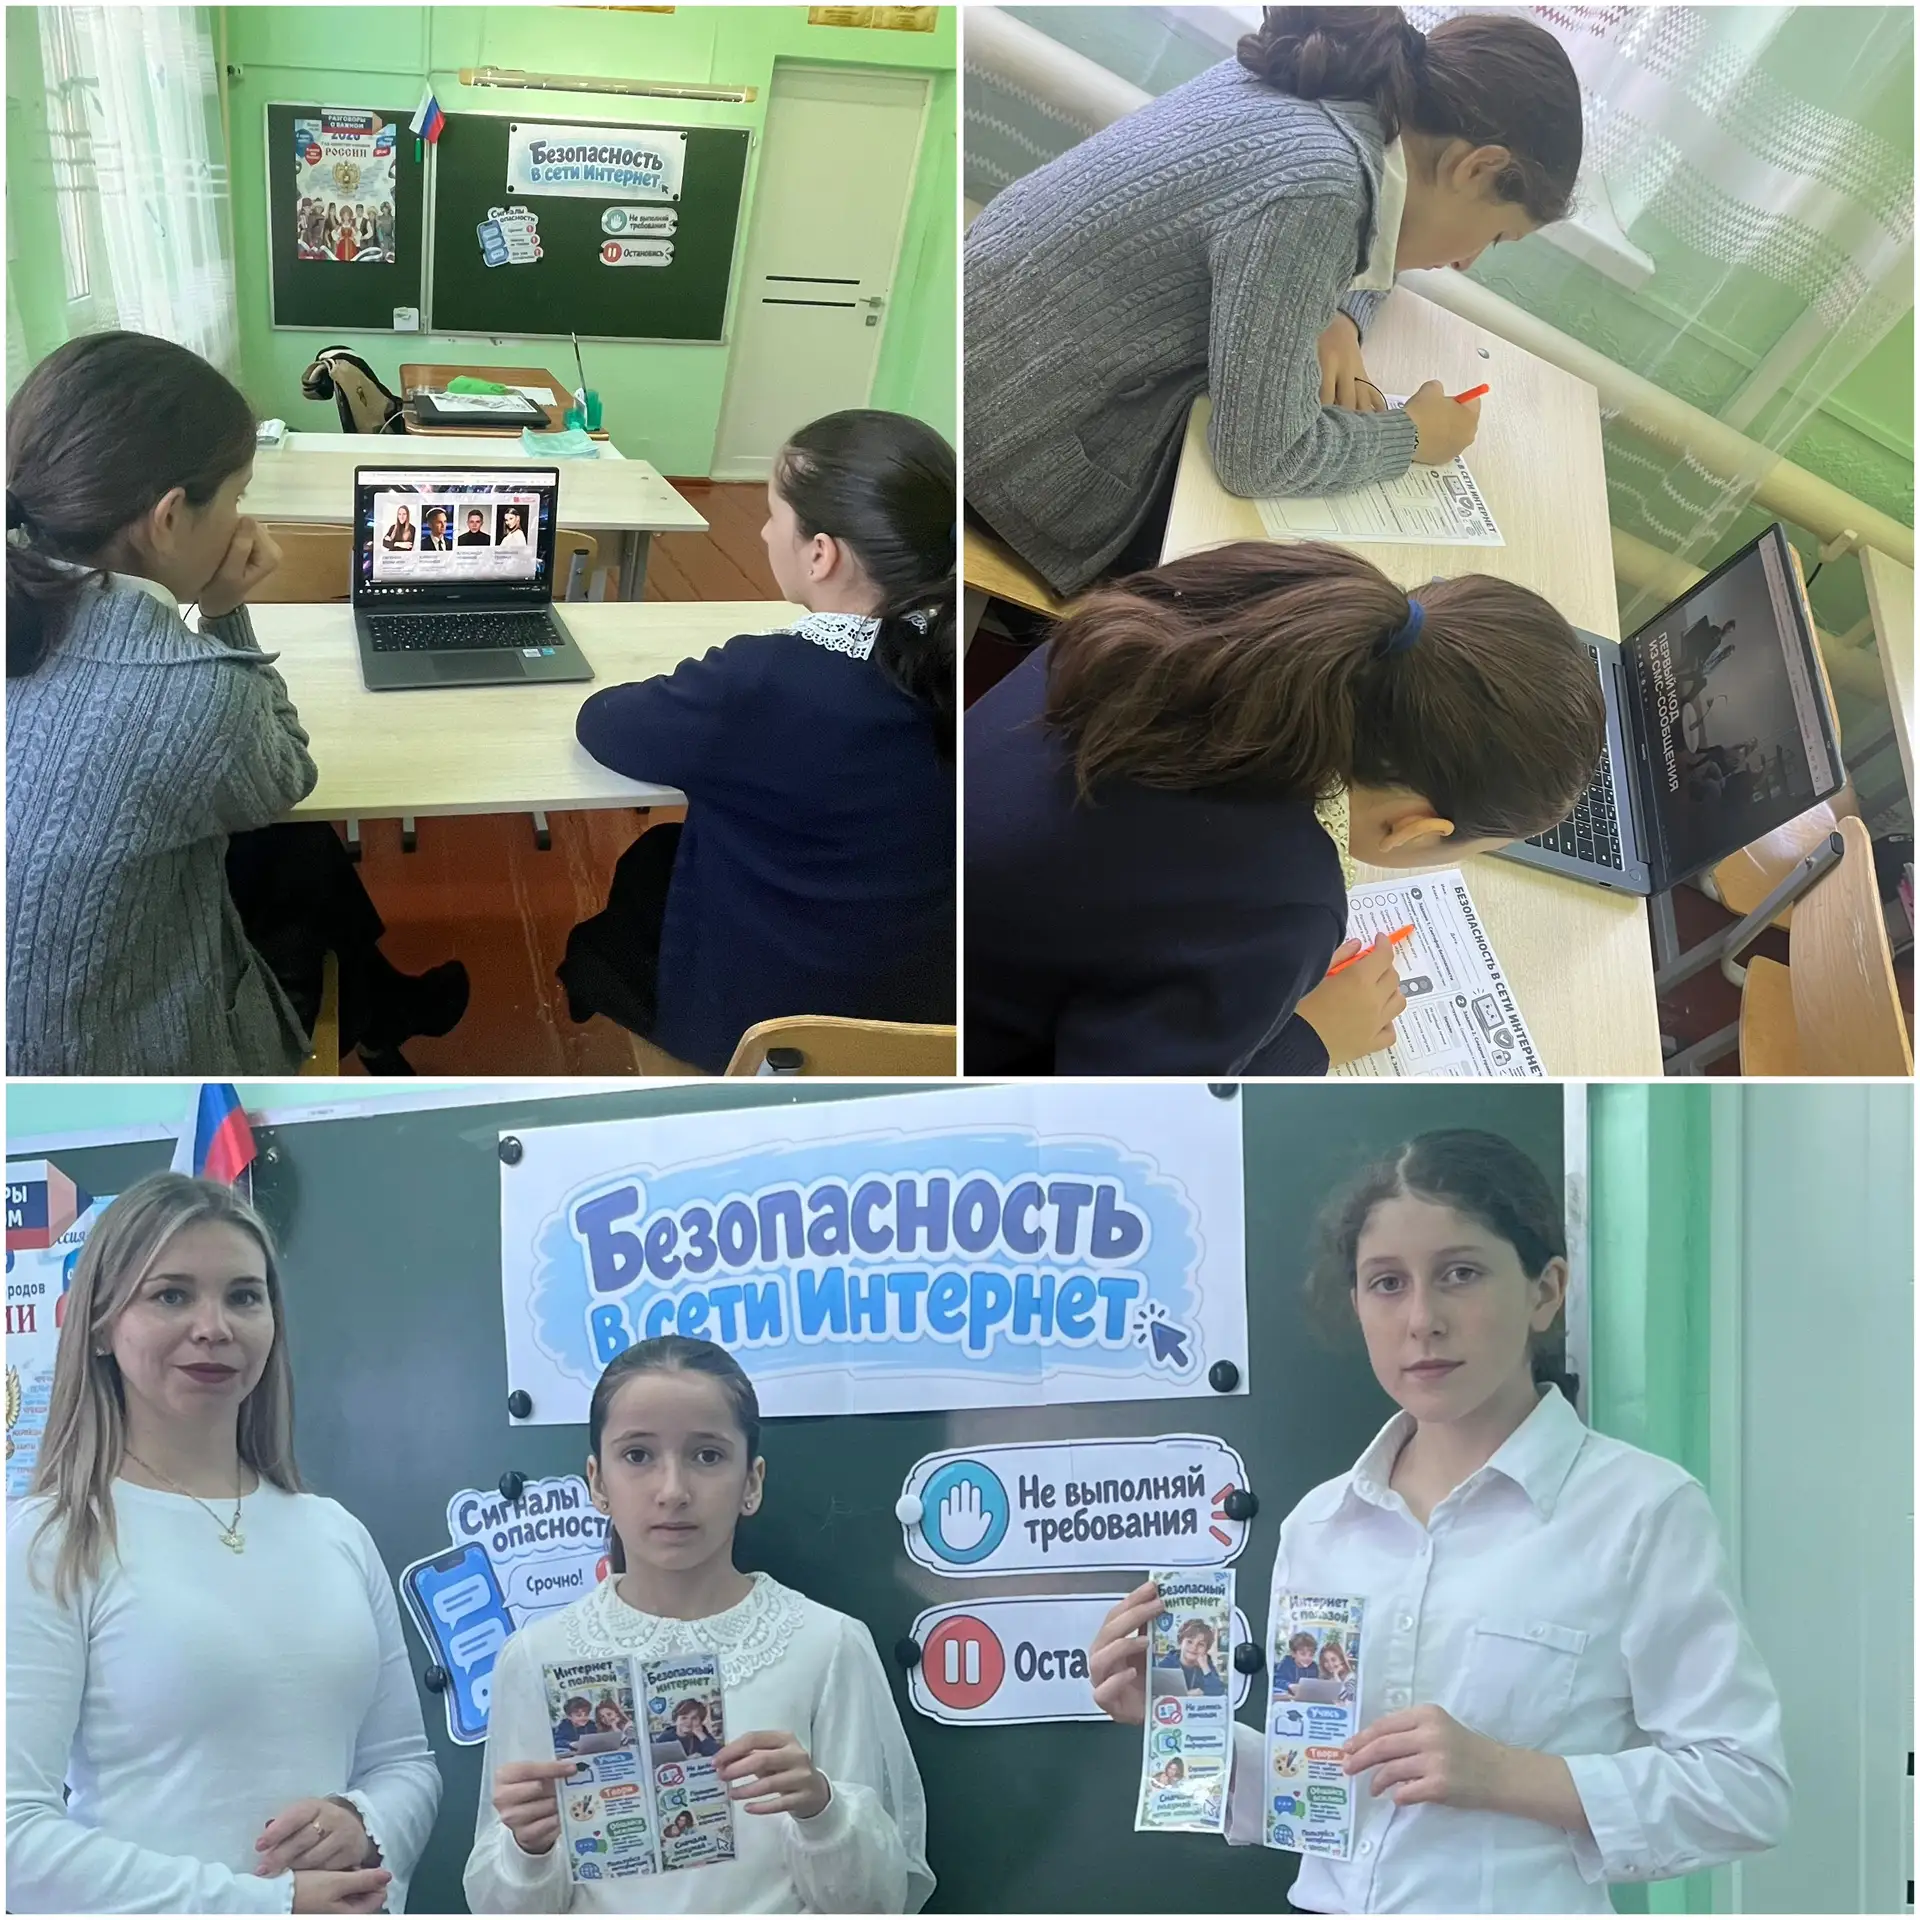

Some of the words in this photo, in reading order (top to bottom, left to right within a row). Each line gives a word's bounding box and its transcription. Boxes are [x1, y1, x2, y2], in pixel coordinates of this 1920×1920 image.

[325, 147, 367, 157] РОССИИ
[529, 140, 663, 171] Безопасность
[531, 167, 541, 181] в
[545, 166, 580, 181] сети
[583, 164, 661, 188] Интернет
[629, 214, 638, 222] Не
[640, 213, 669, 222] выполняй
[630, 221, 667, 230] требования
[623, 248, 664, 258] Остановись
[1648, 639, 1658, 659] ИЗ
[1657, 631, 1676, 690] ПЕРВЫЙ
[1666, 690, 1680, 724] КОД
[1649, 659, 1679, 792] СМС-СООБЩЕНИЯ
[1454, 886, 1494, 970] БЕЗОПАСНОСТЬ
[1490, 972, 1500, 980] В
[1495, 982, 1514, 1012] СЕТИ
[6, 1209, 23, 1228] М
[576, 1177, 1144, 1293] Безопасность
[591, 1303, 631, 1363] в
[644, 1281, 782, 1342] сети
[797, 1266, 1139, 1350] Интернет
[1019, 1474, 1056, 1509] Не
[1064, 1463, 1205, 1507] выполняй
[458, 1486, 580, 1536] Сигналы
[1023, 1507, 1198, 1552] требования
[526, 1568, 583, 1595] Срочно!
[1157, 1583, 1225, 1597] Безопасный
[1165, 1596, 1221, 1608] интернет
[1289, 1595, 1349, 1609] Интернет
[553, 1660, 613, 1680] Интернет
[567, 1671, 616, 1686] пользой
[646, 1663, 714, 1685] Безопасный
[655, 1676, 710, 1692] интернет
[1310, 1707, 1340, 1718] Учись
